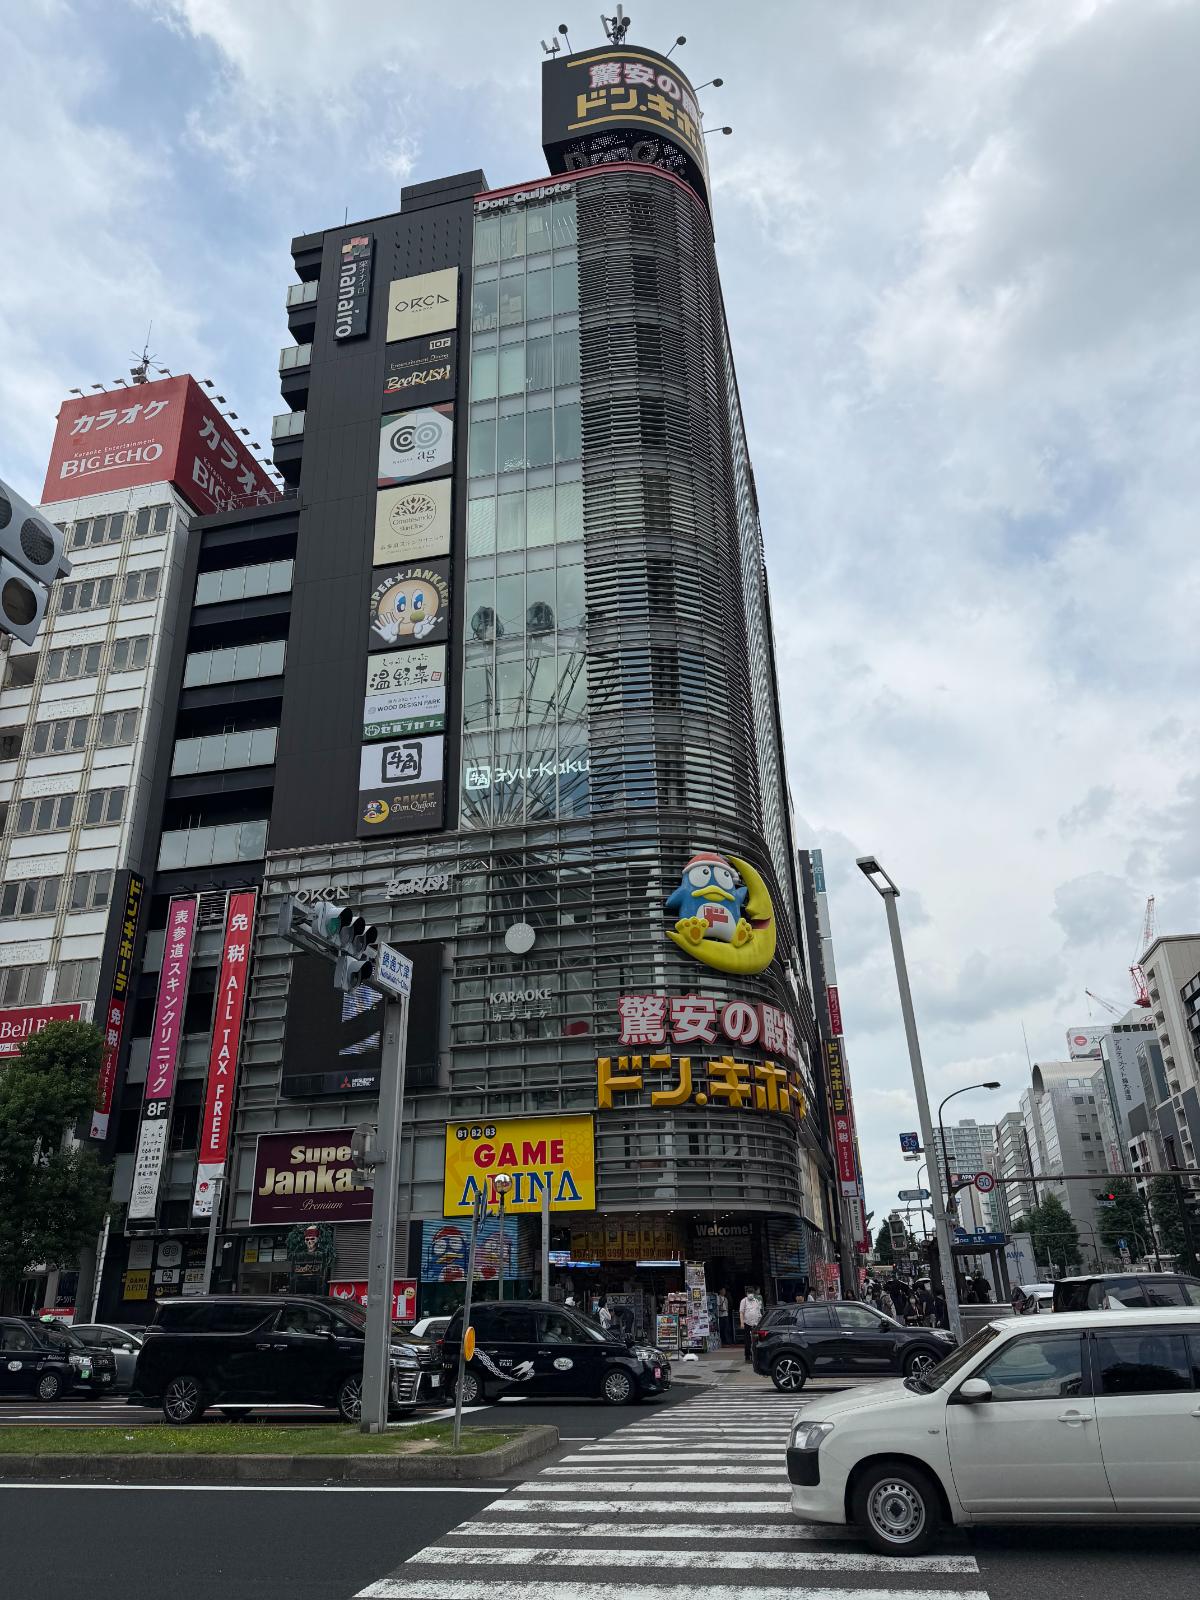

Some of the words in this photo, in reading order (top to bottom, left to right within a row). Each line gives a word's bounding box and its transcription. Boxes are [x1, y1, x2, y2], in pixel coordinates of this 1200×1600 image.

[336, 262, 360, 337] nanairo
[70, 400, 169, 436] カラオケ
[60, 456, 100, 479] BIG
[104, 443, 163, 466] ECHO
[377, 704, 398, 712] WOOD
[398, 700, 423, 710] DESIGN
[387, 751, 418, 773] 牛角
[494, 759, 590, 785] Gyu-Kaku
[704, 905, 729, 929] ド
[227, 913, 249, 963] 免税
[152, 909, 188, 1093] 表参道スキンクリニック
[225, 975, 238, 1021] ALL
[489, 988, 552, 1004] KARAOKE
[216, 1028, 231, 1075] TAX
[147, 1101, 167, 1116] 8F
[210, 1084, 225, 1149] FREE
[457, 1130, 468, 1138] B1
[471, 1128, 482, 1137] B2
[485, 1127, 496, 1136] B3
[290, 1145, 352, 1165] Supe
[473, 1139, 564, 1168] GAME
[258, 1165, 366, 1196] Janka
[978, 1177, 990, 1188] 50
[300, 1198, 345, 1211] Premium
[696, 1224, 753, 1237] Welcome!
